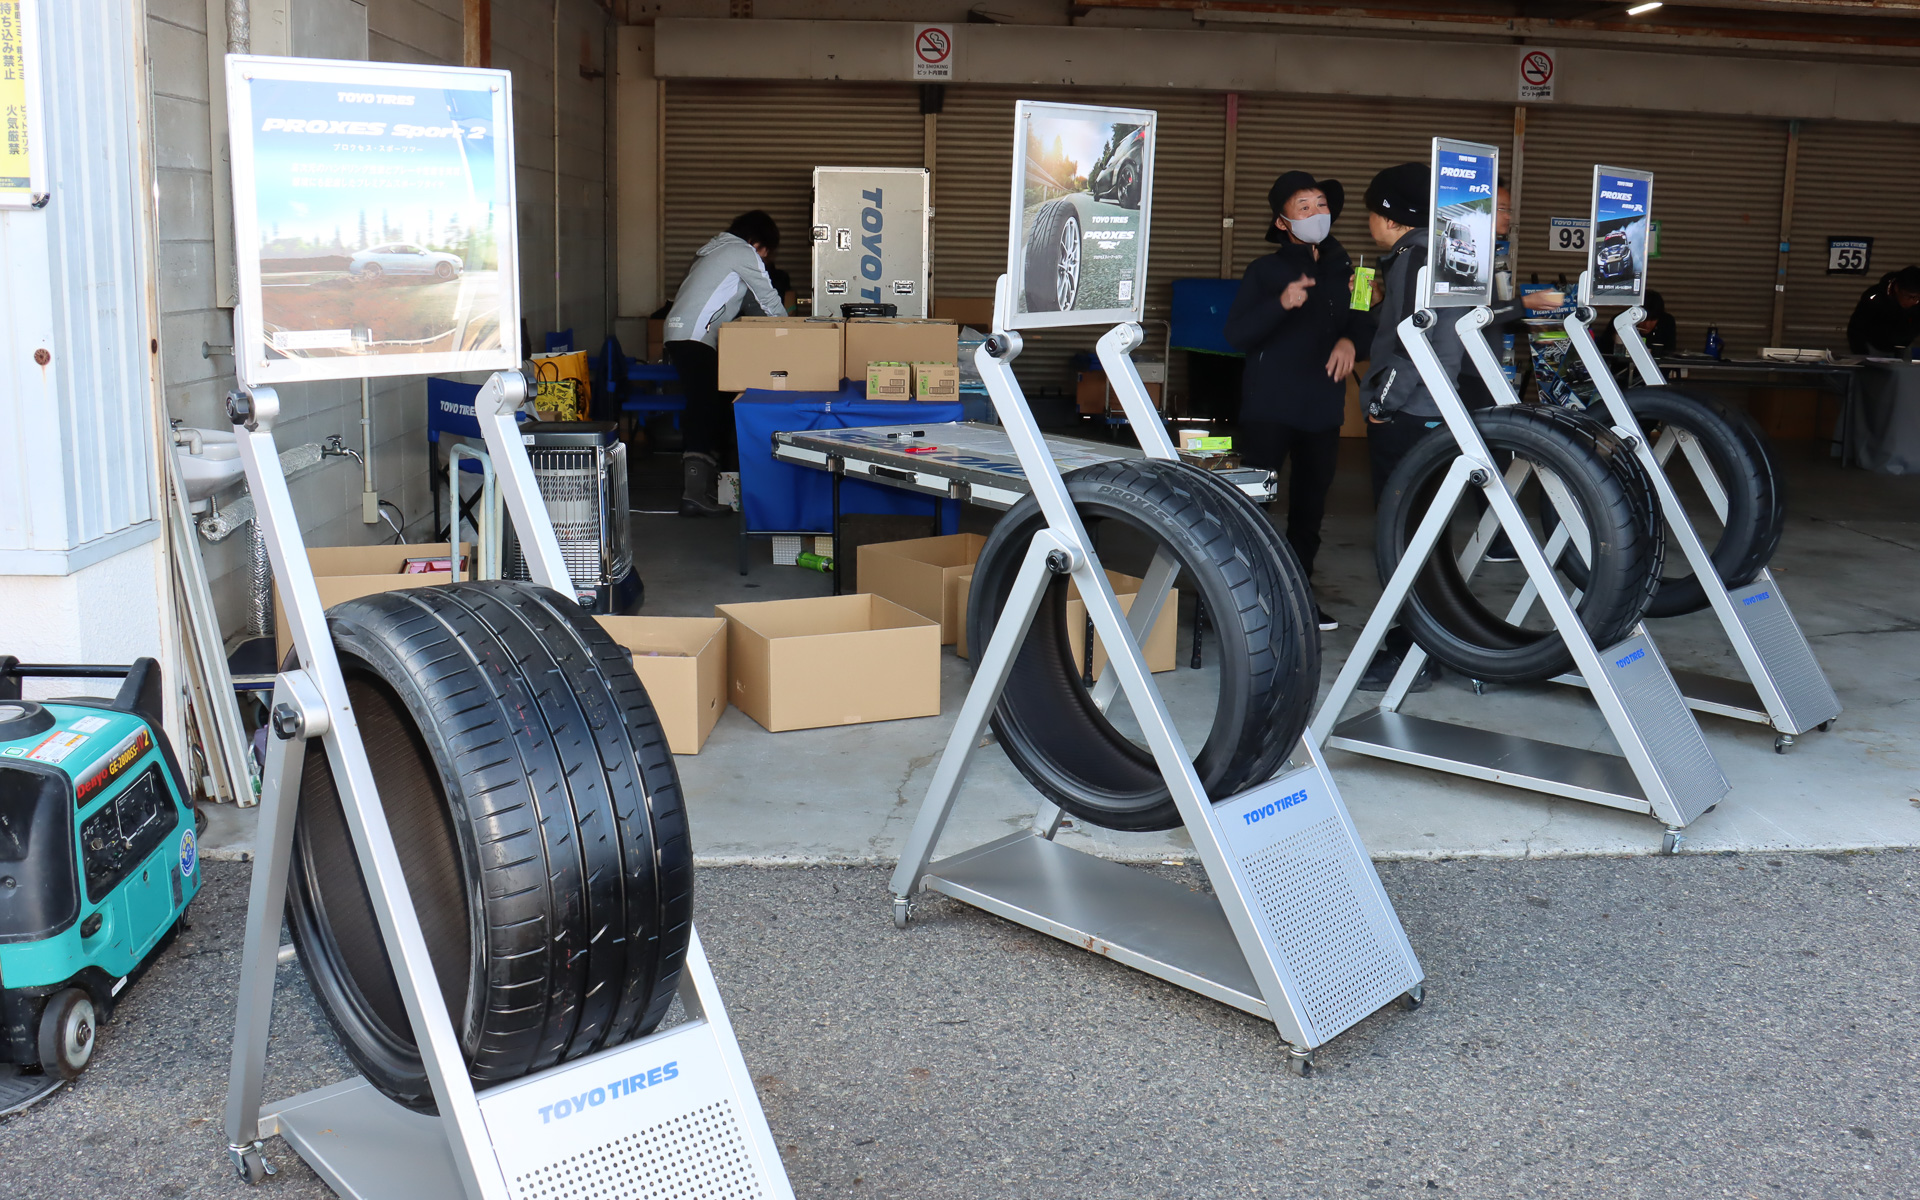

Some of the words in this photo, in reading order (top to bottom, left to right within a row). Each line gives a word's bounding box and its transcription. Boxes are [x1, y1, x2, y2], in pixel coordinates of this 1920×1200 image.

[338, 92, 374, 104] TOYO
[376, 94, 416, 106] TIRES
[6, 104, 20, 154] 火気厳禁
[262, 118, 387, 136] PROXES
[391, 123, 465, 139] Sport
[467, 126, 486, 140] 2
[1440, 167, 1477, 179] PROXES
[1469, 184, 1491, 195] R1R
[1600, 190, 1632, 201] PROXES
[1092, 216, 1109, 224] TOYO
[1110, 216, 1128, 224] TIRES
[860, 188, 883, 280] TOYO
[1083, 231, 1135, 240] PROXES
[1559, 228, 1585, 249] 93
[1837, 250, 1862, 269] 55
[440, 400, 458, 414] TOYO
[1098, 484, 1169, 522] PROXES
[1742, 595, 1757, 606] TOYO
[1756, 592, 1770, 602] TIRES
[1616, 656, 1630, 668] TOYO
[1629, 648, 1645, 663] TIRES
[76, 769, 108, 799] Denyo
[1243, 803, 1275, 825] TOYO
[1274, 789, 1308, 812] TIRES
[538, 1087, 606, 1124] TOYO
[607, 1061, 679, 1100] TIRES
